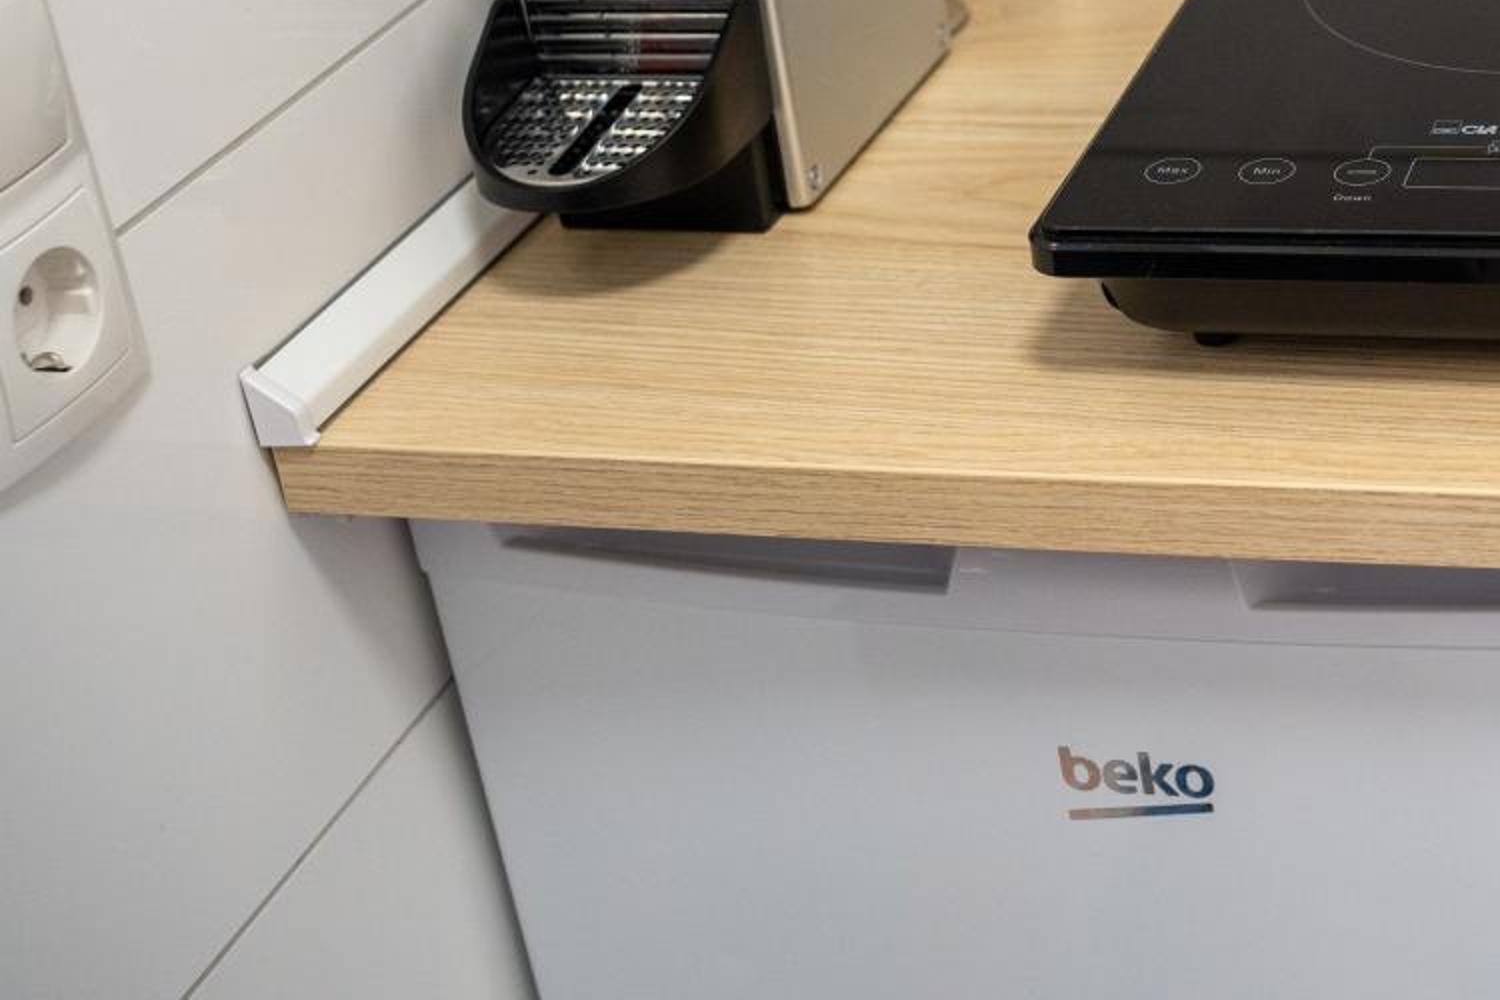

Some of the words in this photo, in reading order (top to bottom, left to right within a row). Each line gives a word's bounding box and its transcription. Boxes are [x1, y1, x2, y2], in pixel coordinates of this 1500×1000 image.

[1156, 166, 1191, 175] Max
[1252, 166, 1282, 176] Min
[1057, 745, 1215, 799] beko
